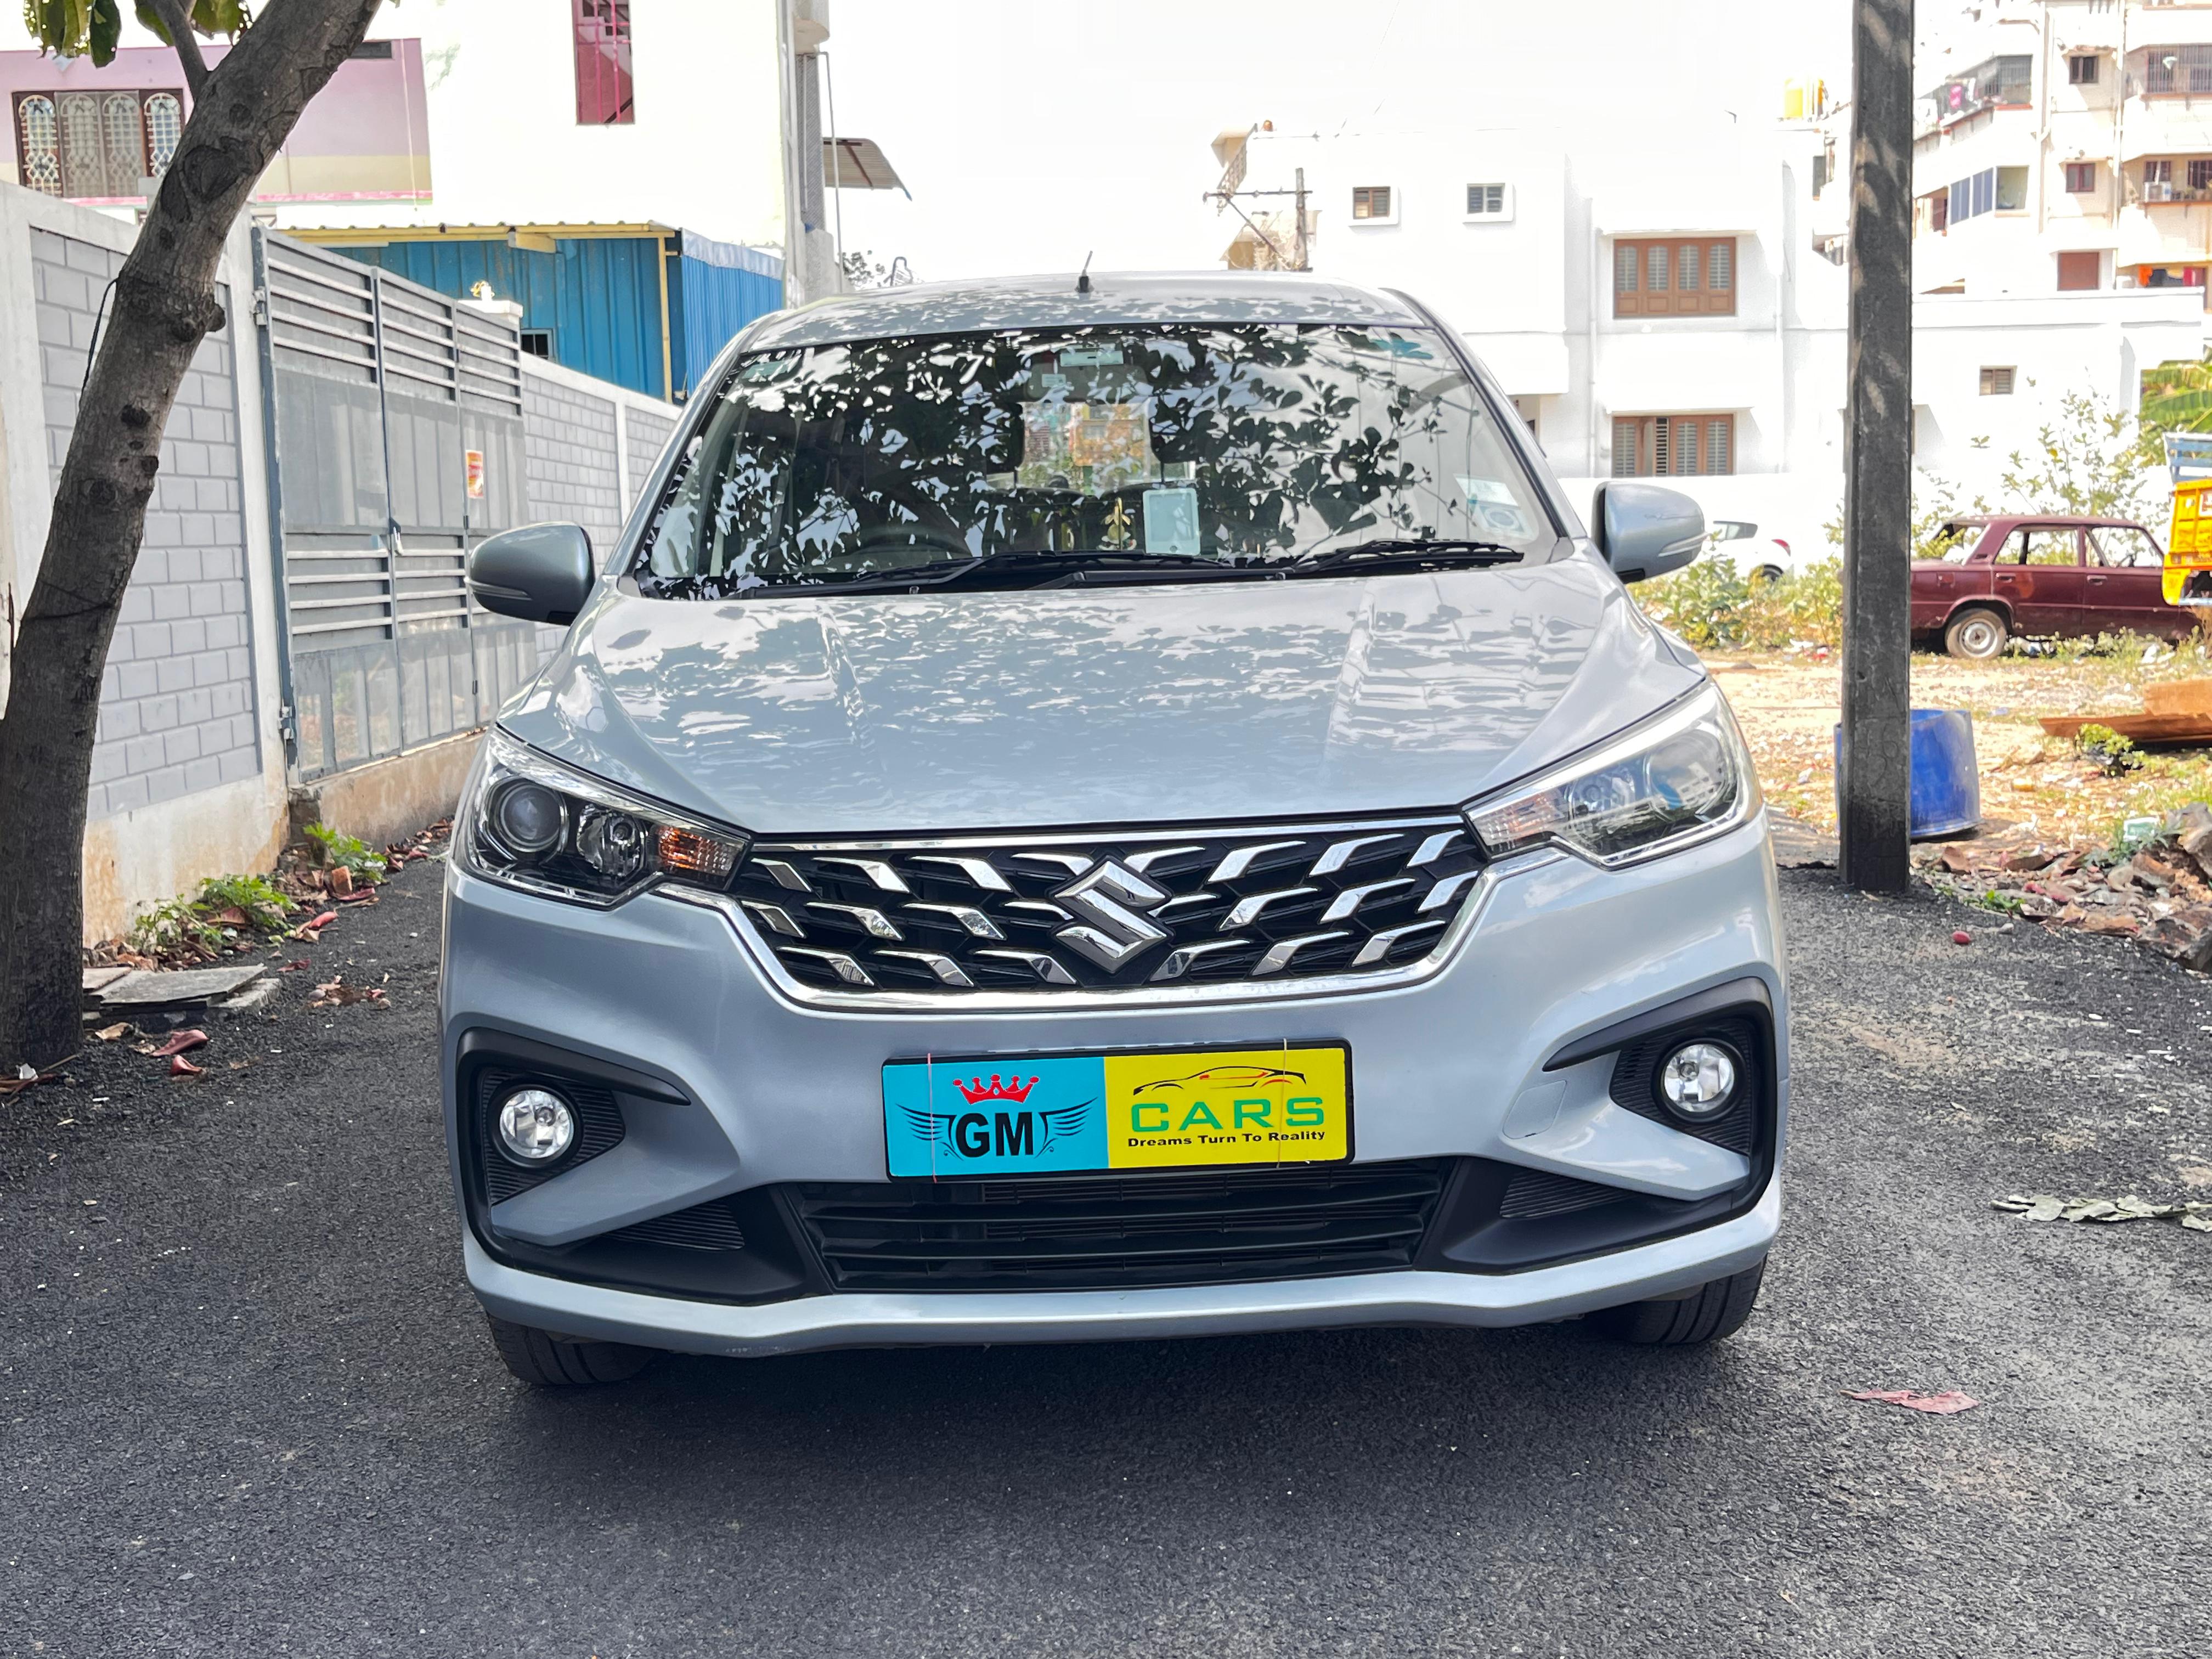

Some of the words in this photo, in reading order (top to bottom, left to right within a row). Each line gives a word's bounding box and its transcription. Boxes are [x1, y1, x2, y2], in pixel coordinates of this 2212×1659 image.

[955, 1111, 1034, 1158] GM
[1131, 1097, 1324, 1132] CARS
[1127, 1138, 1192, 1147] Dreams
[1198, 1135, 1236, 1144] Turn
[1242, 1133, 1262, 1143] To
[1268, 1131, 1325, 1142] Reality
